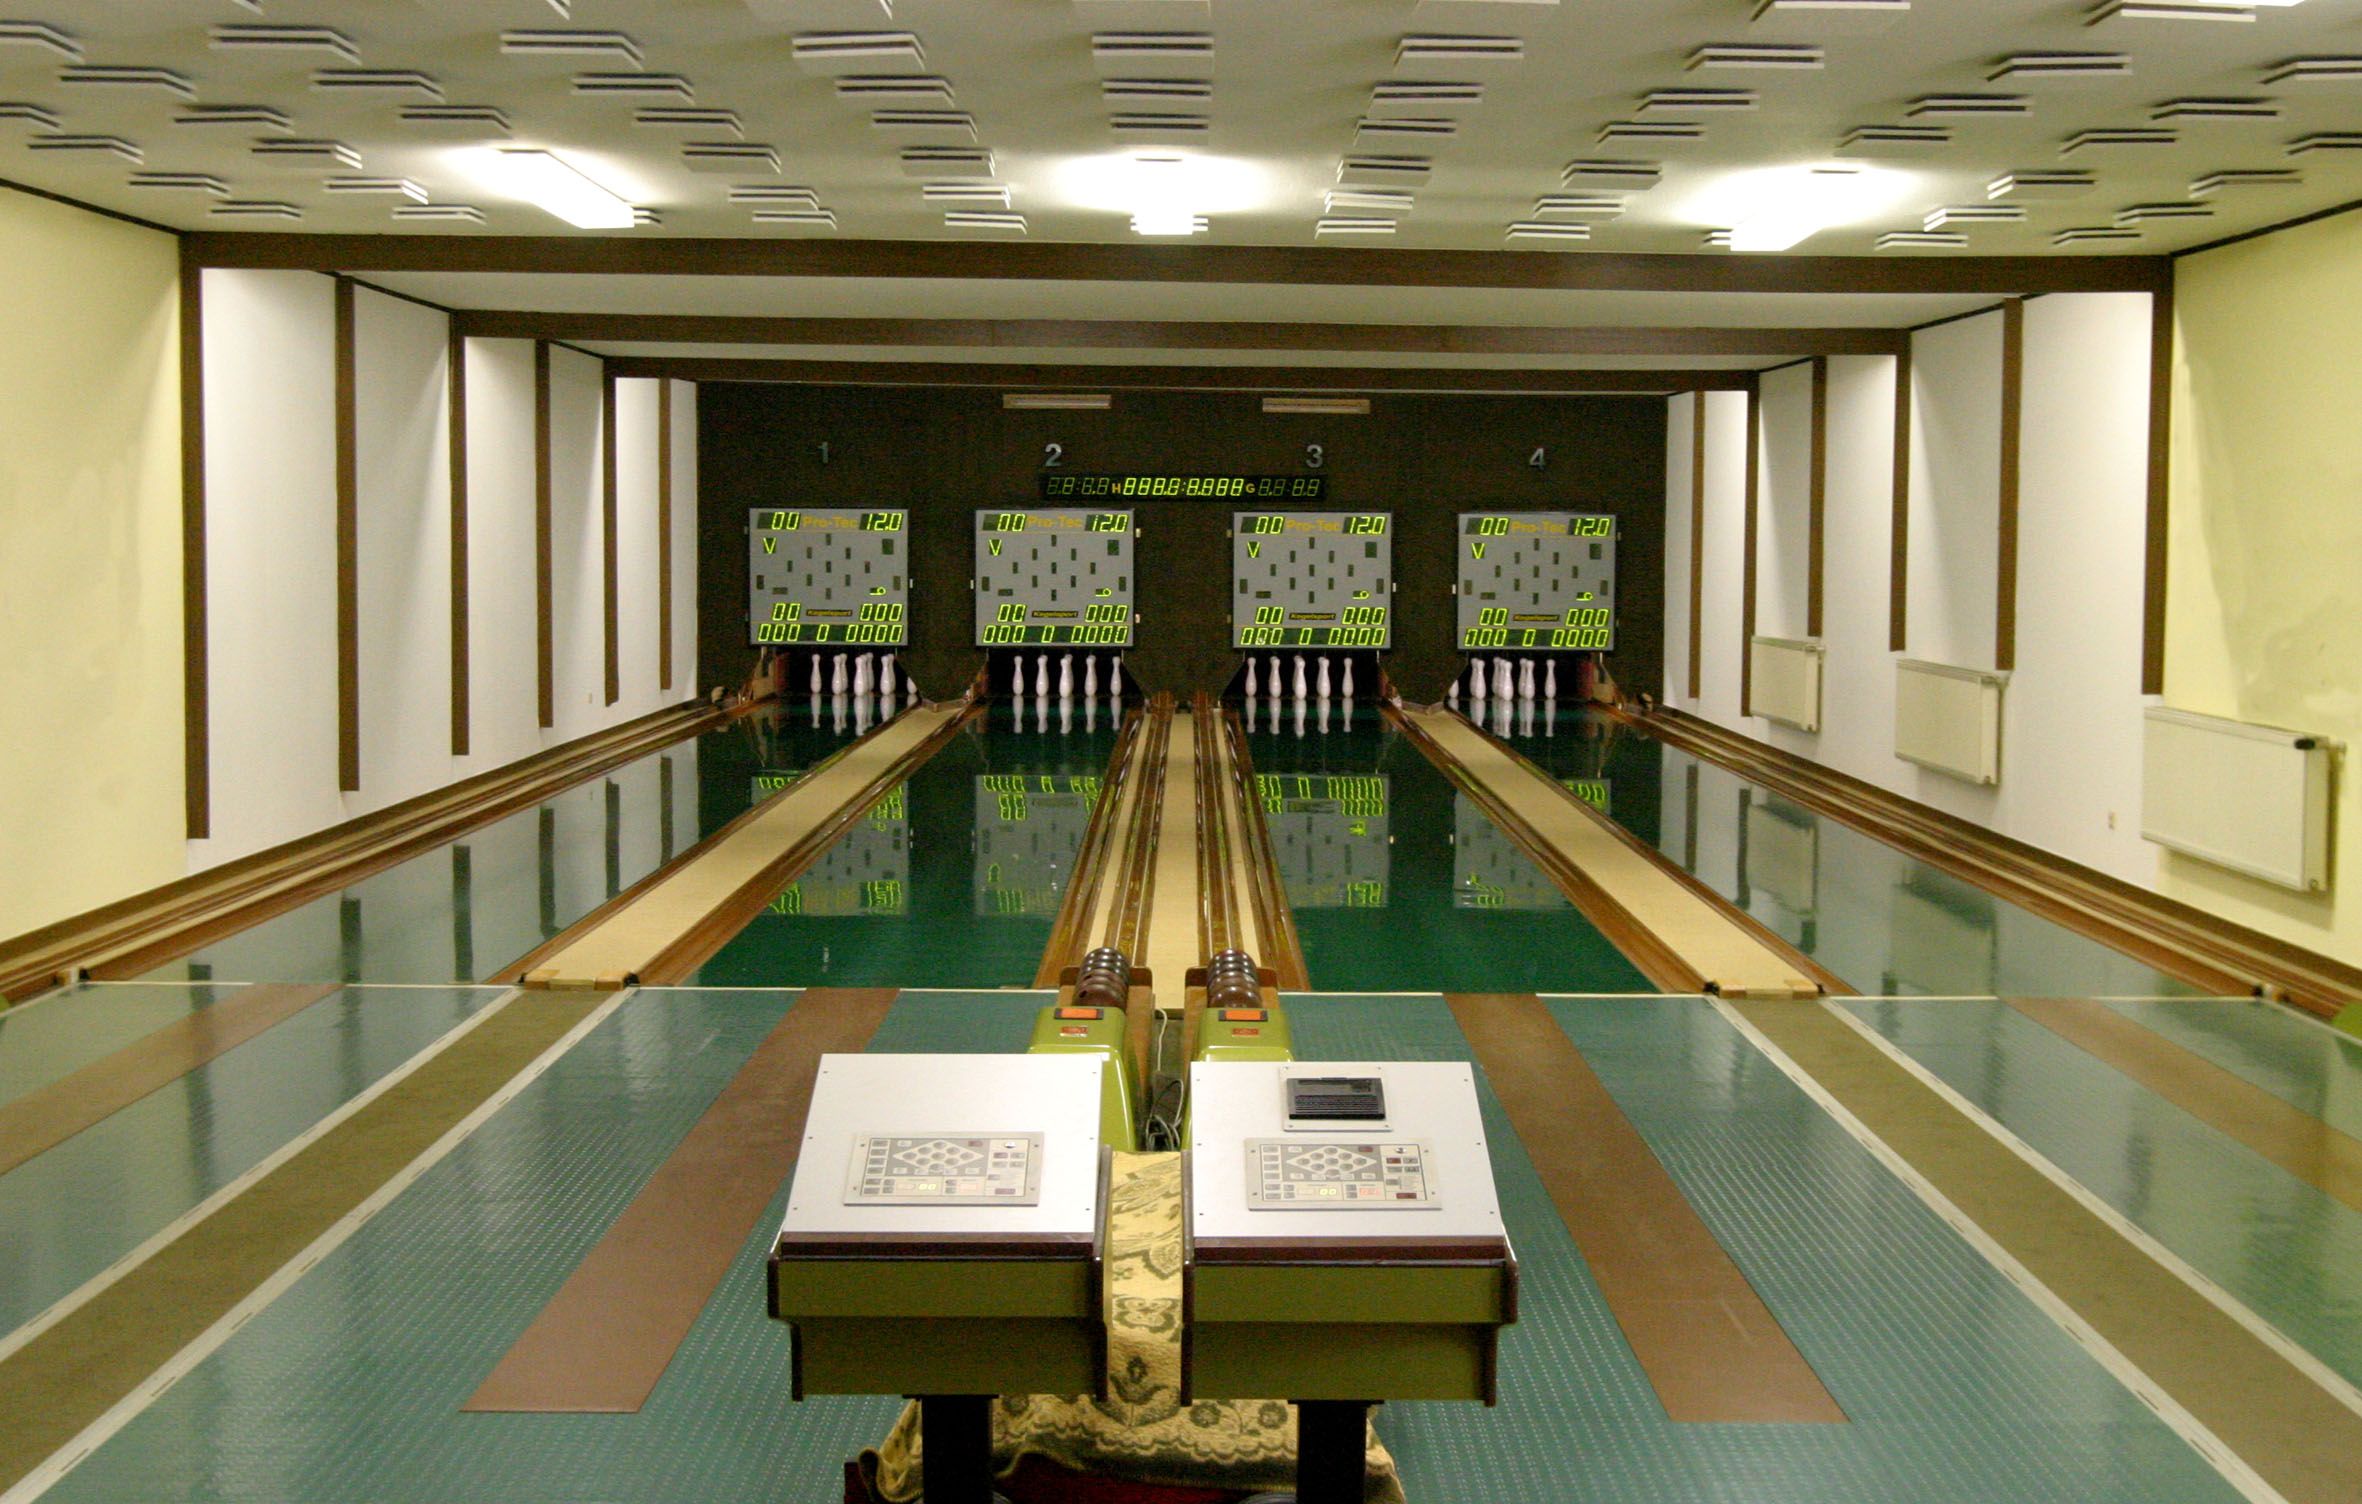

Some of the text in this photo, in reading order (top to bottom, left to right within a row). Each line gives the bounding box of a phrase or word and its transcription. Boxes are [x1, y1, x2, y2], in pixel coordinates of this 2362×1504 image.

[818, 441, 828, 463] 1
[1045, 444, 1062, 466] 2
[1306, 444, 1323, 467] 3
[1530, 448, 1545, 469] 4
[1112, 483, 1121, 493] H
[1246, 483, 1255, 493] G
[772, 512, 800, 530] 00
[997, 514, 1025, 532] 00
[1256, 516, 1284, 534] 00
[1480, 518, 1509, 536] 00
[763, 537, 776, 554] V
[989, 539, 1002, 556] V
[1247, 541, 1260, 558] V
[1471, 543, 1485, 559] V
[772, 603, 800, 621] 00
[860, 603, 902, 622] 000
[997, 604, 1026, 622] 00
[1085, 605, 1128, 623] 000
[1255, 607, 1284, 624] 00
[1342, 607, 1385, 625] 000
[1479, 608, 1507, 626] 00
[1566, 609, 1609, 627] 000
[758, 624, 903, 643] 000 0 0000
[983, 625, 1128, 644] 000 0 0000
[1241, 627, 1385, 645] 000 0 0000
[1465, 629, 1608, 648] 000 0 0000
